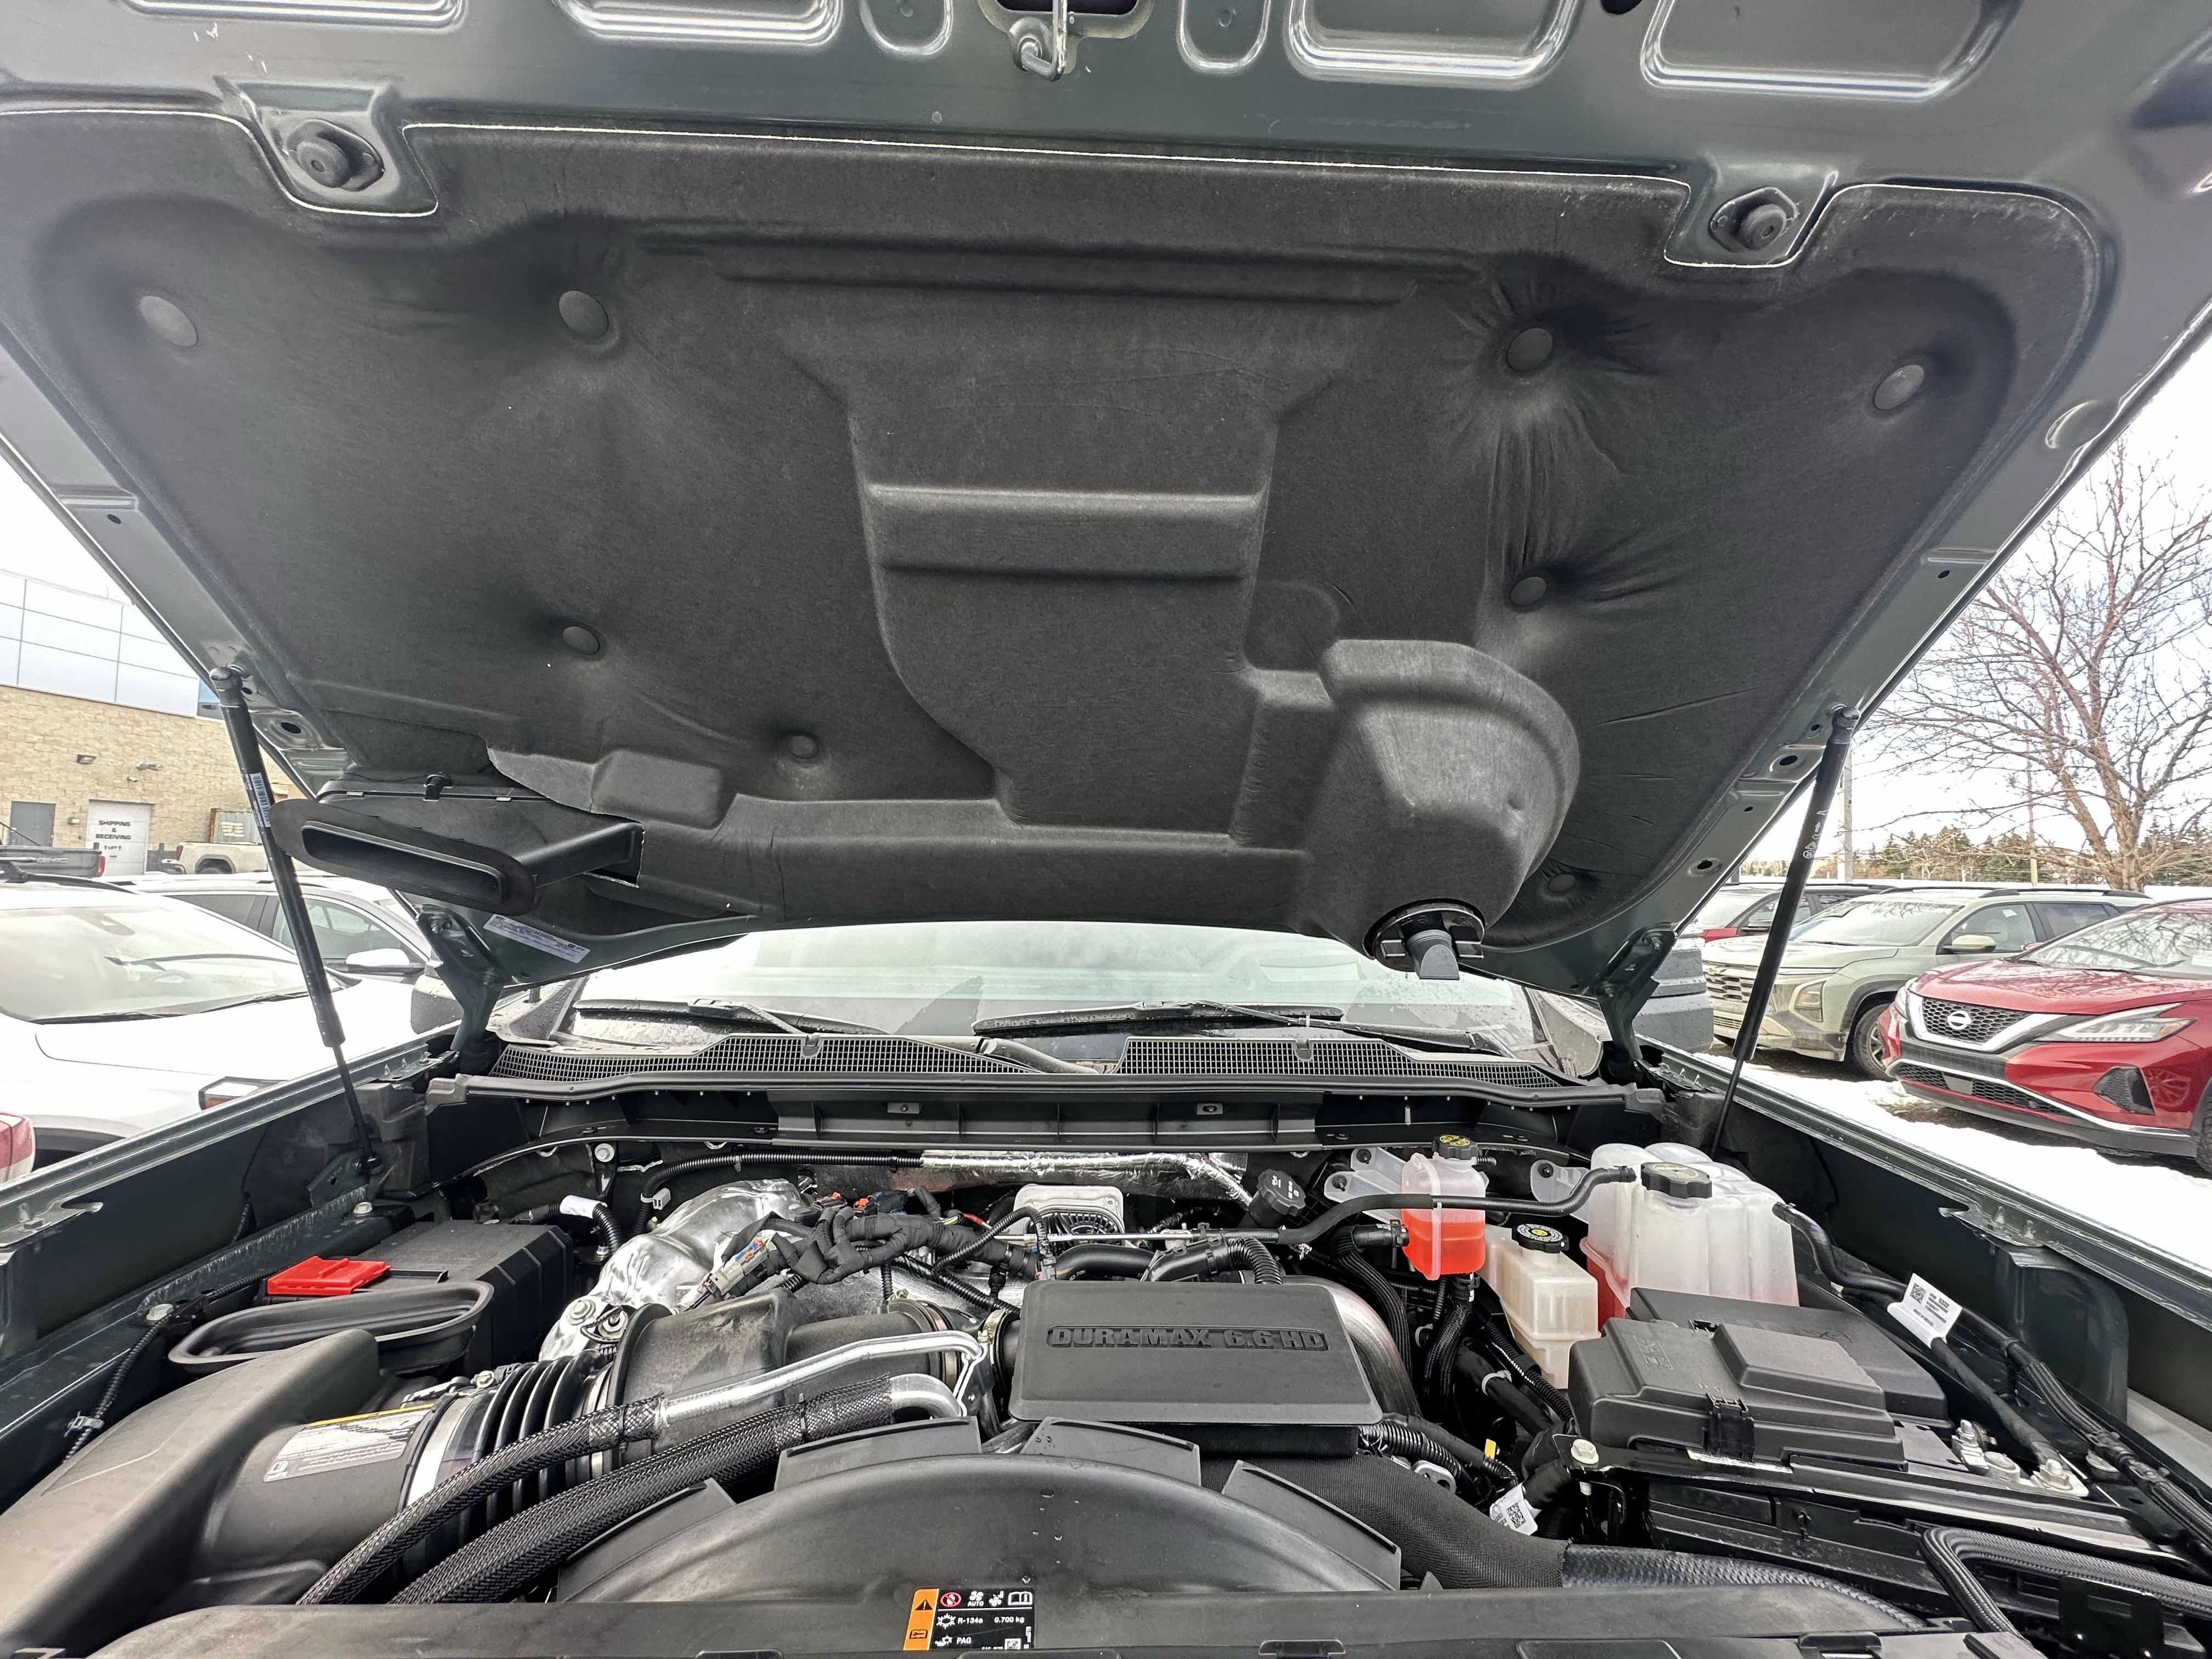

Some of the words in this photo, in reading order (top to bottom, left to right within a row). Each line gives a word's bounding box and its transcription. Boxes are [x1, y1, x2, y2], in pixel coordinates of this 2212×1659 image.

[1051, 1328, 1212, 1347] DURAMAX
[1224, 1329, 1274, 1348] 6.6
[1280, 1330, 1325, 1350] HD
[956, 1637, 972, 1645] PAG
